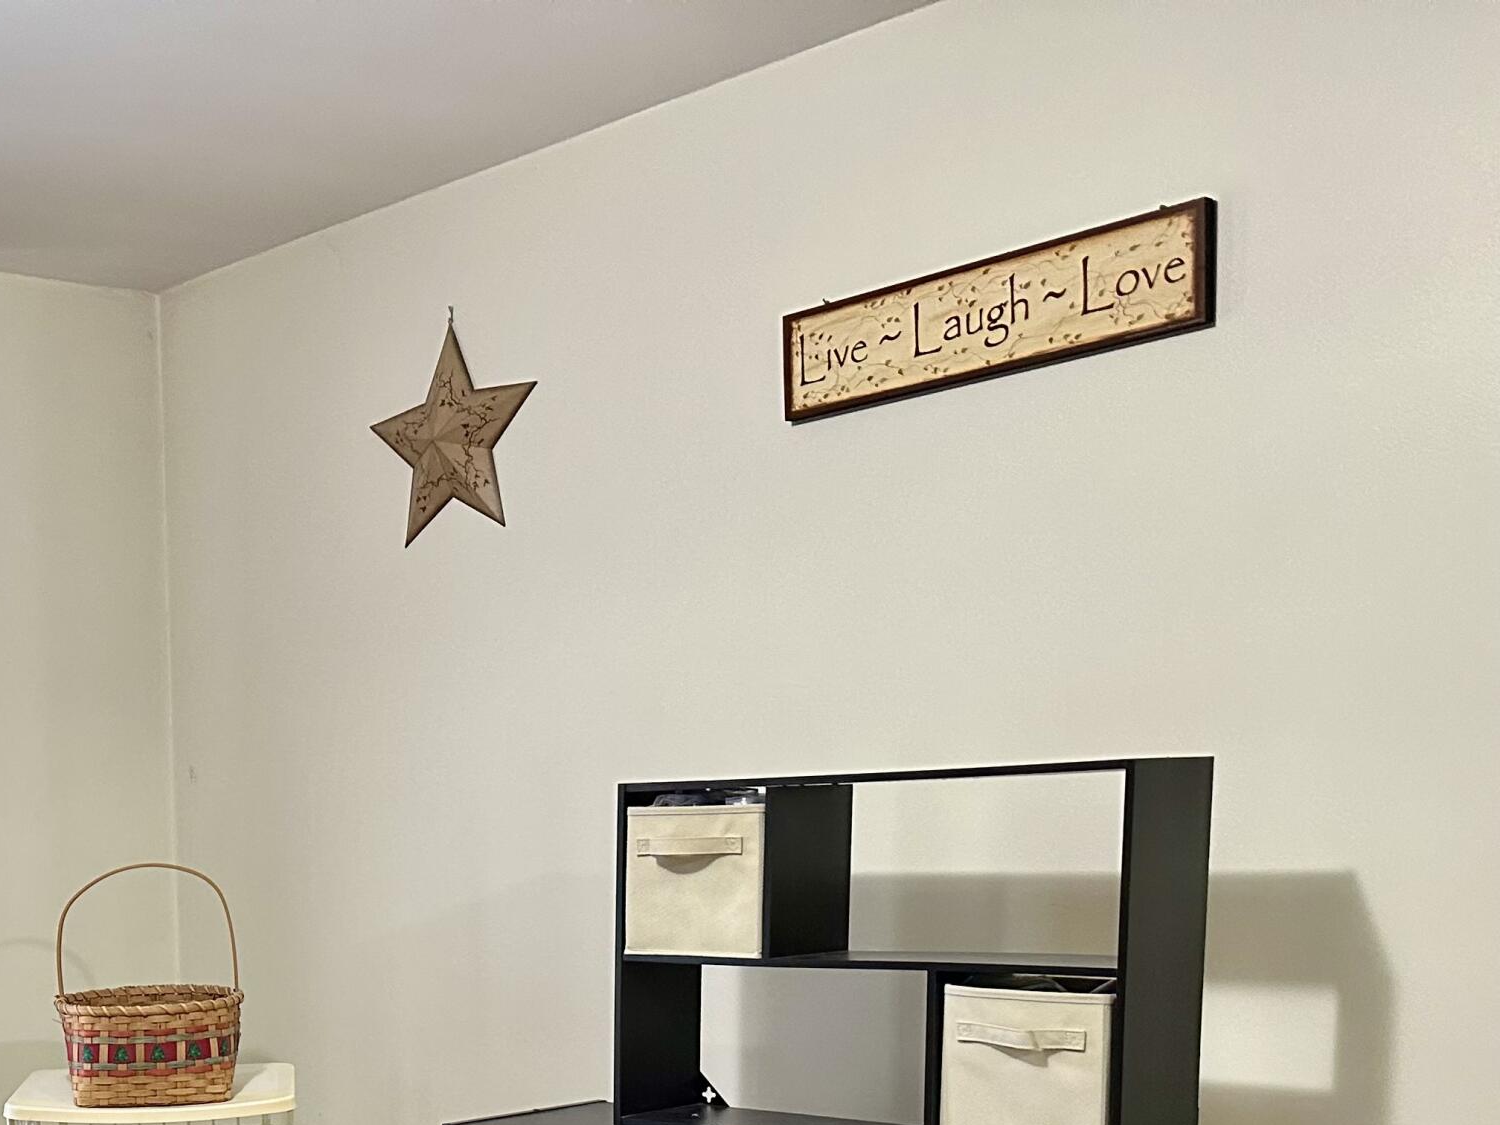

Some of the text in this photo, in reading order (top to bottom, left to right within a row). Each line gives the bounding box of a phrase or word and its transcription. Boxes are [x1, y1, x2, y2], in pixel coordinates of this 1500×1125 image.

[799, 333, 868, 386] Live
[912, 273, 1030, 359] Laugh
[1081, 255, 1187, 317] Love
